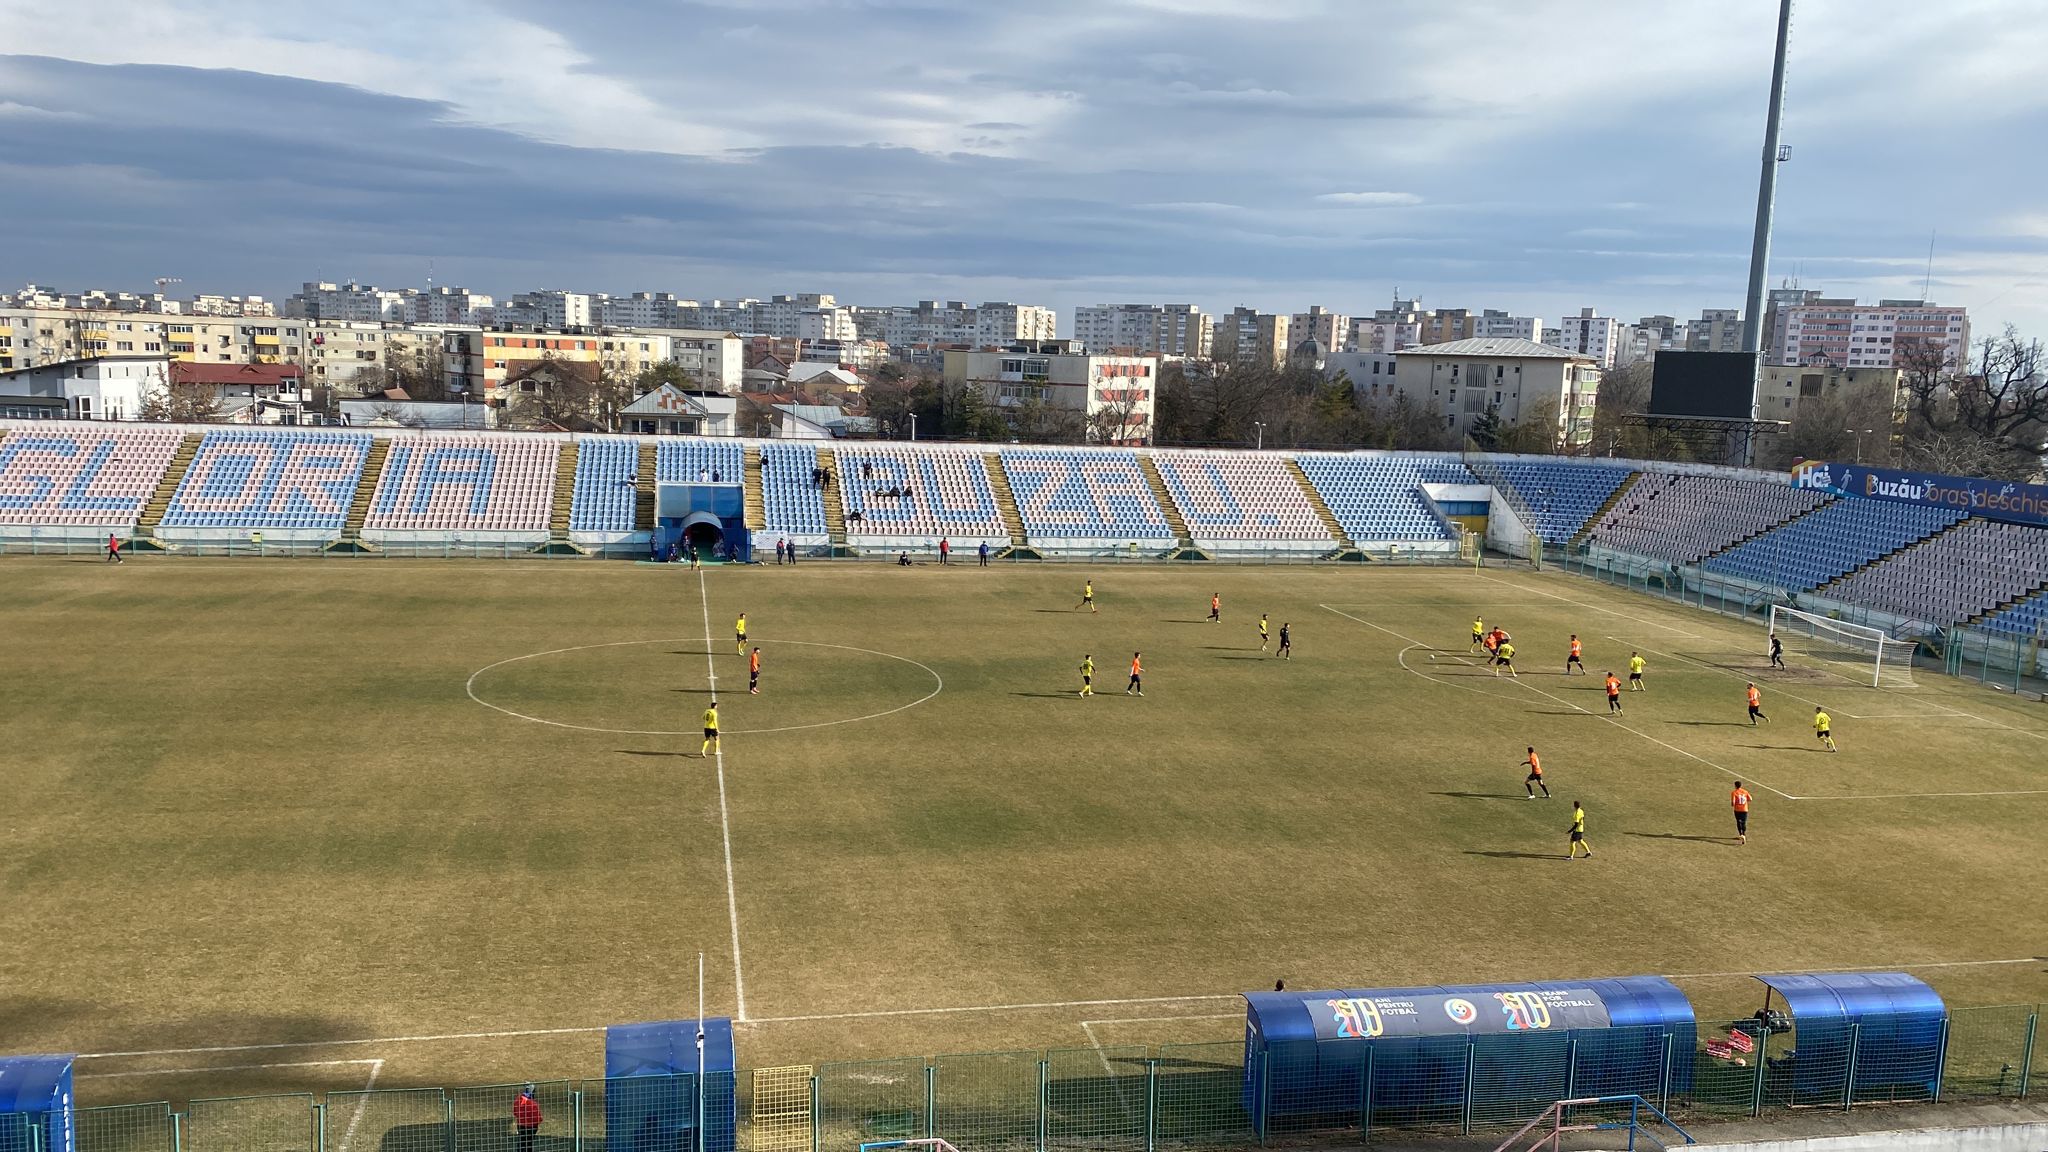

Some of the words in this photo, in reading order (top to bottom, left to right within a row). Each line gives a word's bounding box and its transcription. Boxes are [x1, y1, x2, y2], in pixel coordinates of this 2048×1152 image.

[1377, 1001, 1414, 1009] PENTRU
[1546, 1000, 1595, 1008] FOOTBALL
[1380, 1008, 1418, 1016] FOTBAL
